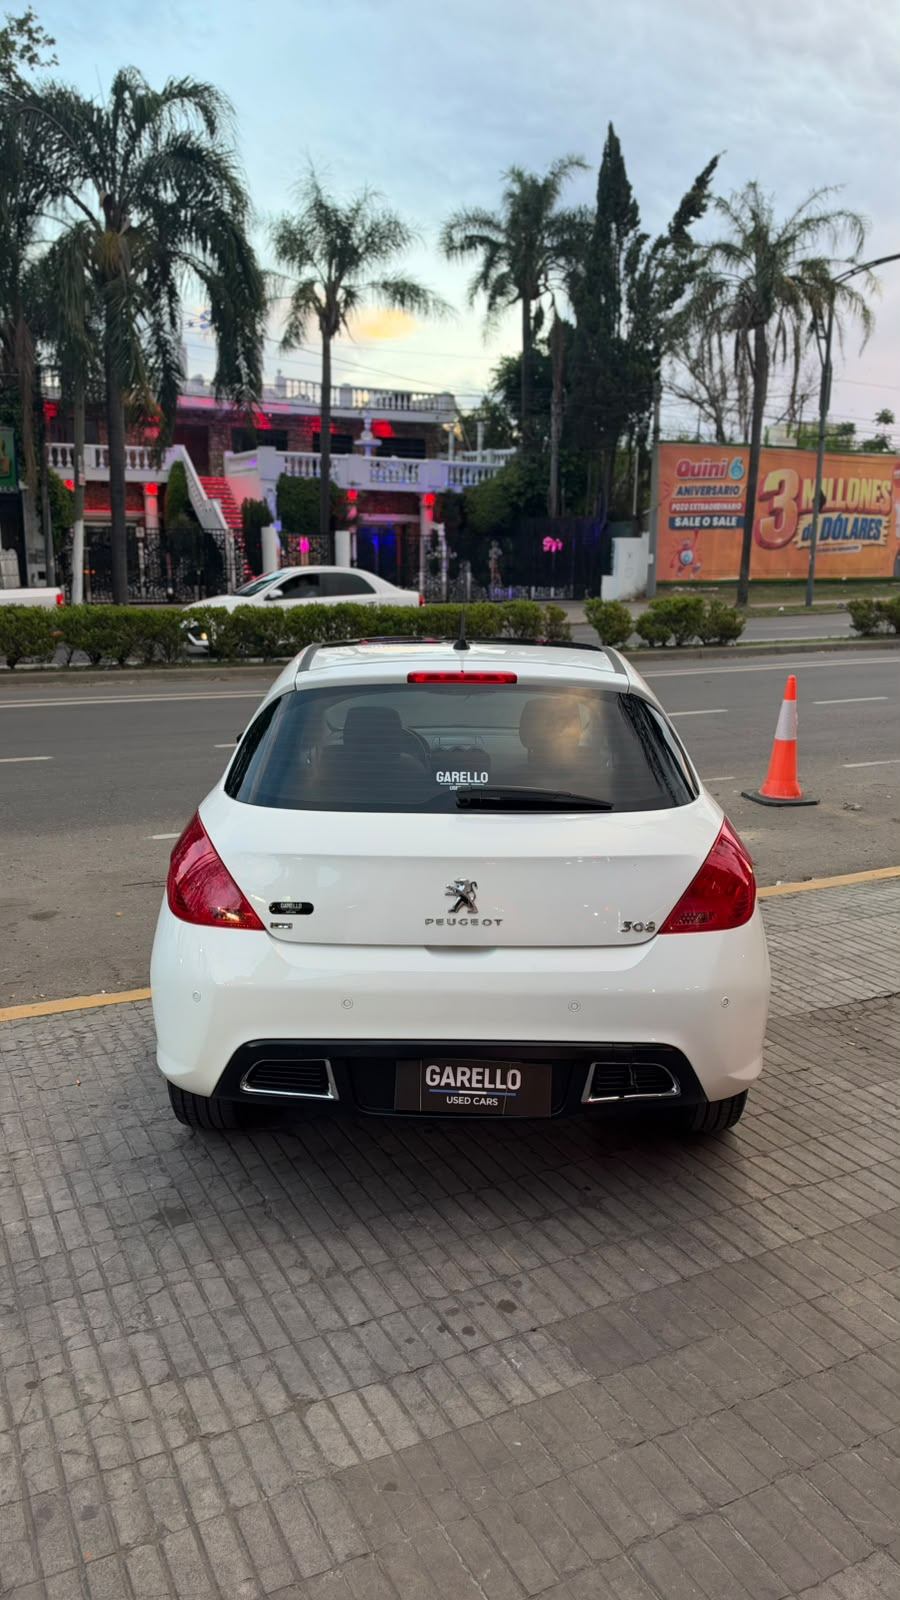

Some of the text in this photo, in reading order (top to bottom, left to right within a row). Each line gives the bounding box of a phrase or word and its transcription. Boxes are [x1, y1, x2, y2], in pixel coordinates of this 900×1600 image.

[676, 456, 745, 480] Quini 6
[676, 485, 740, 497] ANIVERSARIO
[758, 469, 799, 548] 3
[675, 516, 738, 527] SALE O SALE
[819, 512, 883, 541] DÓLARES
[436, 771, 488, 783] GARELLO
[424, 918, 503, 926] PEUGEOT
[620, 921, 656, 933] 308
[425, 1064, 522, 1090] GARELLO
[446, 1096, 498, 1105] USED CARS
